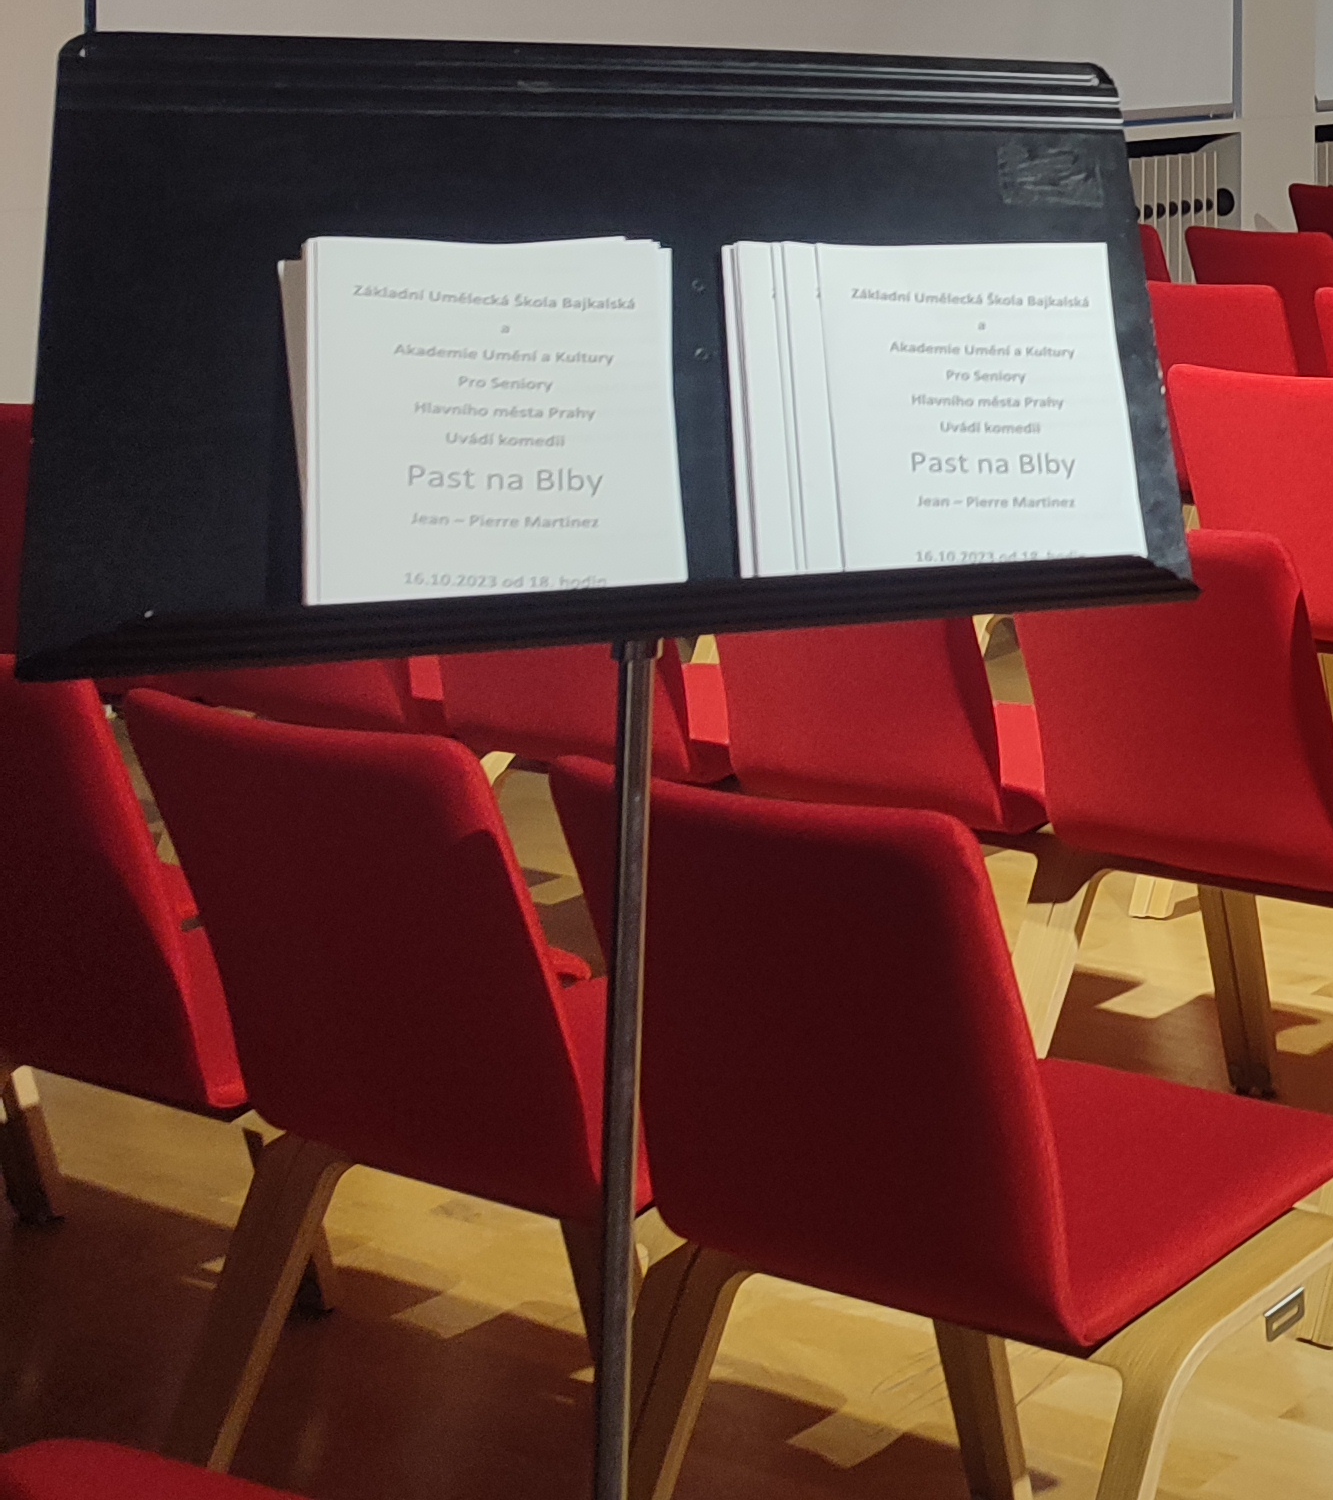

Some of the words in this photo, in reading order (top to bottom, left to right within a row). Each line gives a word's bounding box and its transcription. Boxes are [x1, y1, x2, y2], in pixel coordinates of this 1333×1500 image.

[352, 284, 425, 301] Základní
[428, 290, 510, 307] Umělecká
[513, 292, 558, 309] Škola
[561, 296, 636, 313] Bajkalská
[850, 287, 911, 303] Základní
[913, 292, 984, 306] Umělecká
[986, 291, 1024, 307] Škola
[1026, 294, 1090, 311] Bajkalská
[499, 324, 511, 334] a
[977, 321, 987, 331] a
[393, 343, 478, 360] Akademie
[482, 348, 538, 363] Umění
[540, 353, 551, 363] a
[555, 350, 615, 367] Kultury
[889, 340, 961, 356] Akademie
[963, 344, 1011, 357] Umění
[1013, 347, 1023, 357] a
[1025, 345, 1076, 361] Kultury
[457, 375, 487, 389] Pro
[490, 376, 554, 394] Seniory
[945, 368, 971, 382] Pro
[973, 369, 1027, 385] Seniory
[911, 393, 975, 408] Hlavního
[977, 395, 1022, 409] města
[1023, 395, 1065, 411] Prahy
[413, 401, 489, 418] Hlavního
[492, 405, 545, 419] města
[547, 406, 596, 422] Prahy
[939, 420, 982, 434] Uvádí
[983, 421, 1042, 435] komedii
[444, 431, 495, 446] Uvádí
[497, 433, 566, 448] komedii
[910, 451, 970, 475] Past
[977, 457, 1010, 476] na
[1018, 451, 1076, 481] Blby
[407, 464, 476, 490] Past
[486, 472, 524, 492] na
[536, 467, 605, 499] Blby
[916, 494, 951, 508] Jean
[965, 495, 1010, 509] Pierre
[1012, 495, 1076, 509] Martinez
[410, 512, 450, 526] Jean
[468, 514, 520, 529] Pierre
[524, 515, 599, 529] Martinez
[916, 550, 995, 563] 16.102023
[501, 575, 524, 588] od
